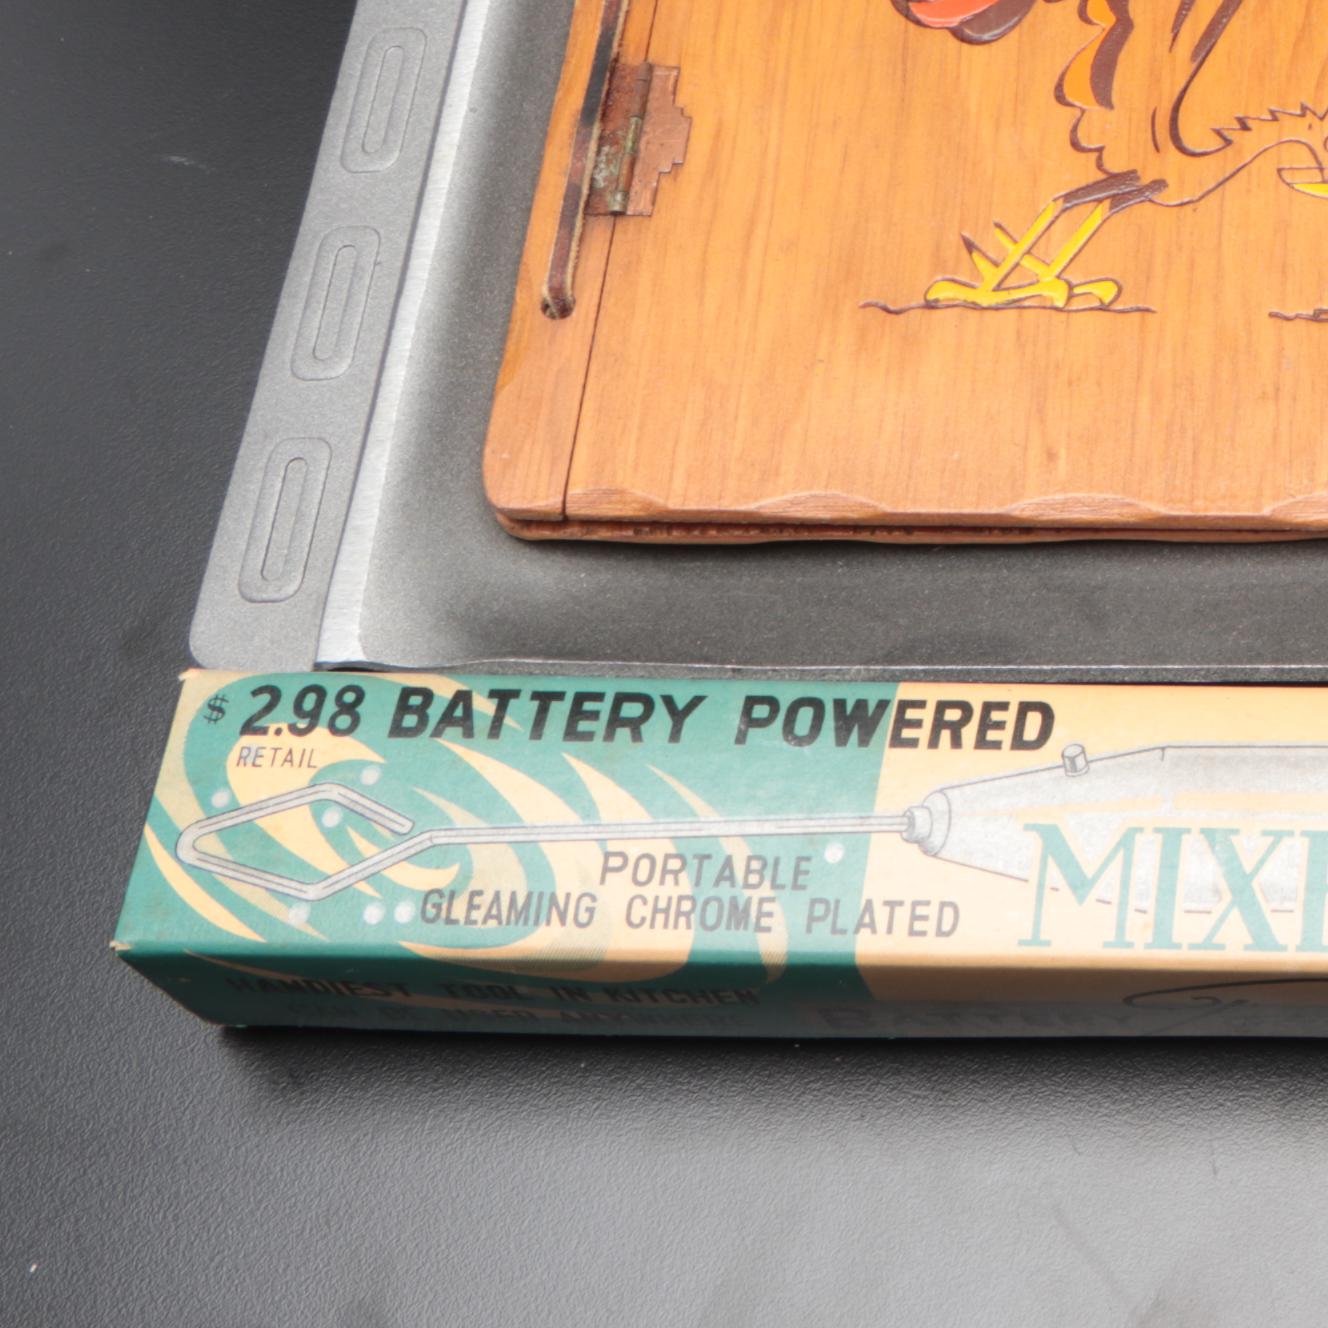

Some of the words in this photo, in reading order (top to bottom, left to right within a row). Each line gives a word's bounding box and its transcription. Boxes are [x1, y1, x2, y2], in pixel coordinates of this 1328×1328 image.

[388, 685, 707, 745] BATTERY
[734, 692, 1055, 752] POWERED
[235, 745, 318, 771] RETAIL
[599, 849, 812, 893] PORTABLE
[420, 888, 597, 929] GLEAMING
[624, 892, 774, 934] CHROME
[805, 897, 960, 939] PLATED
